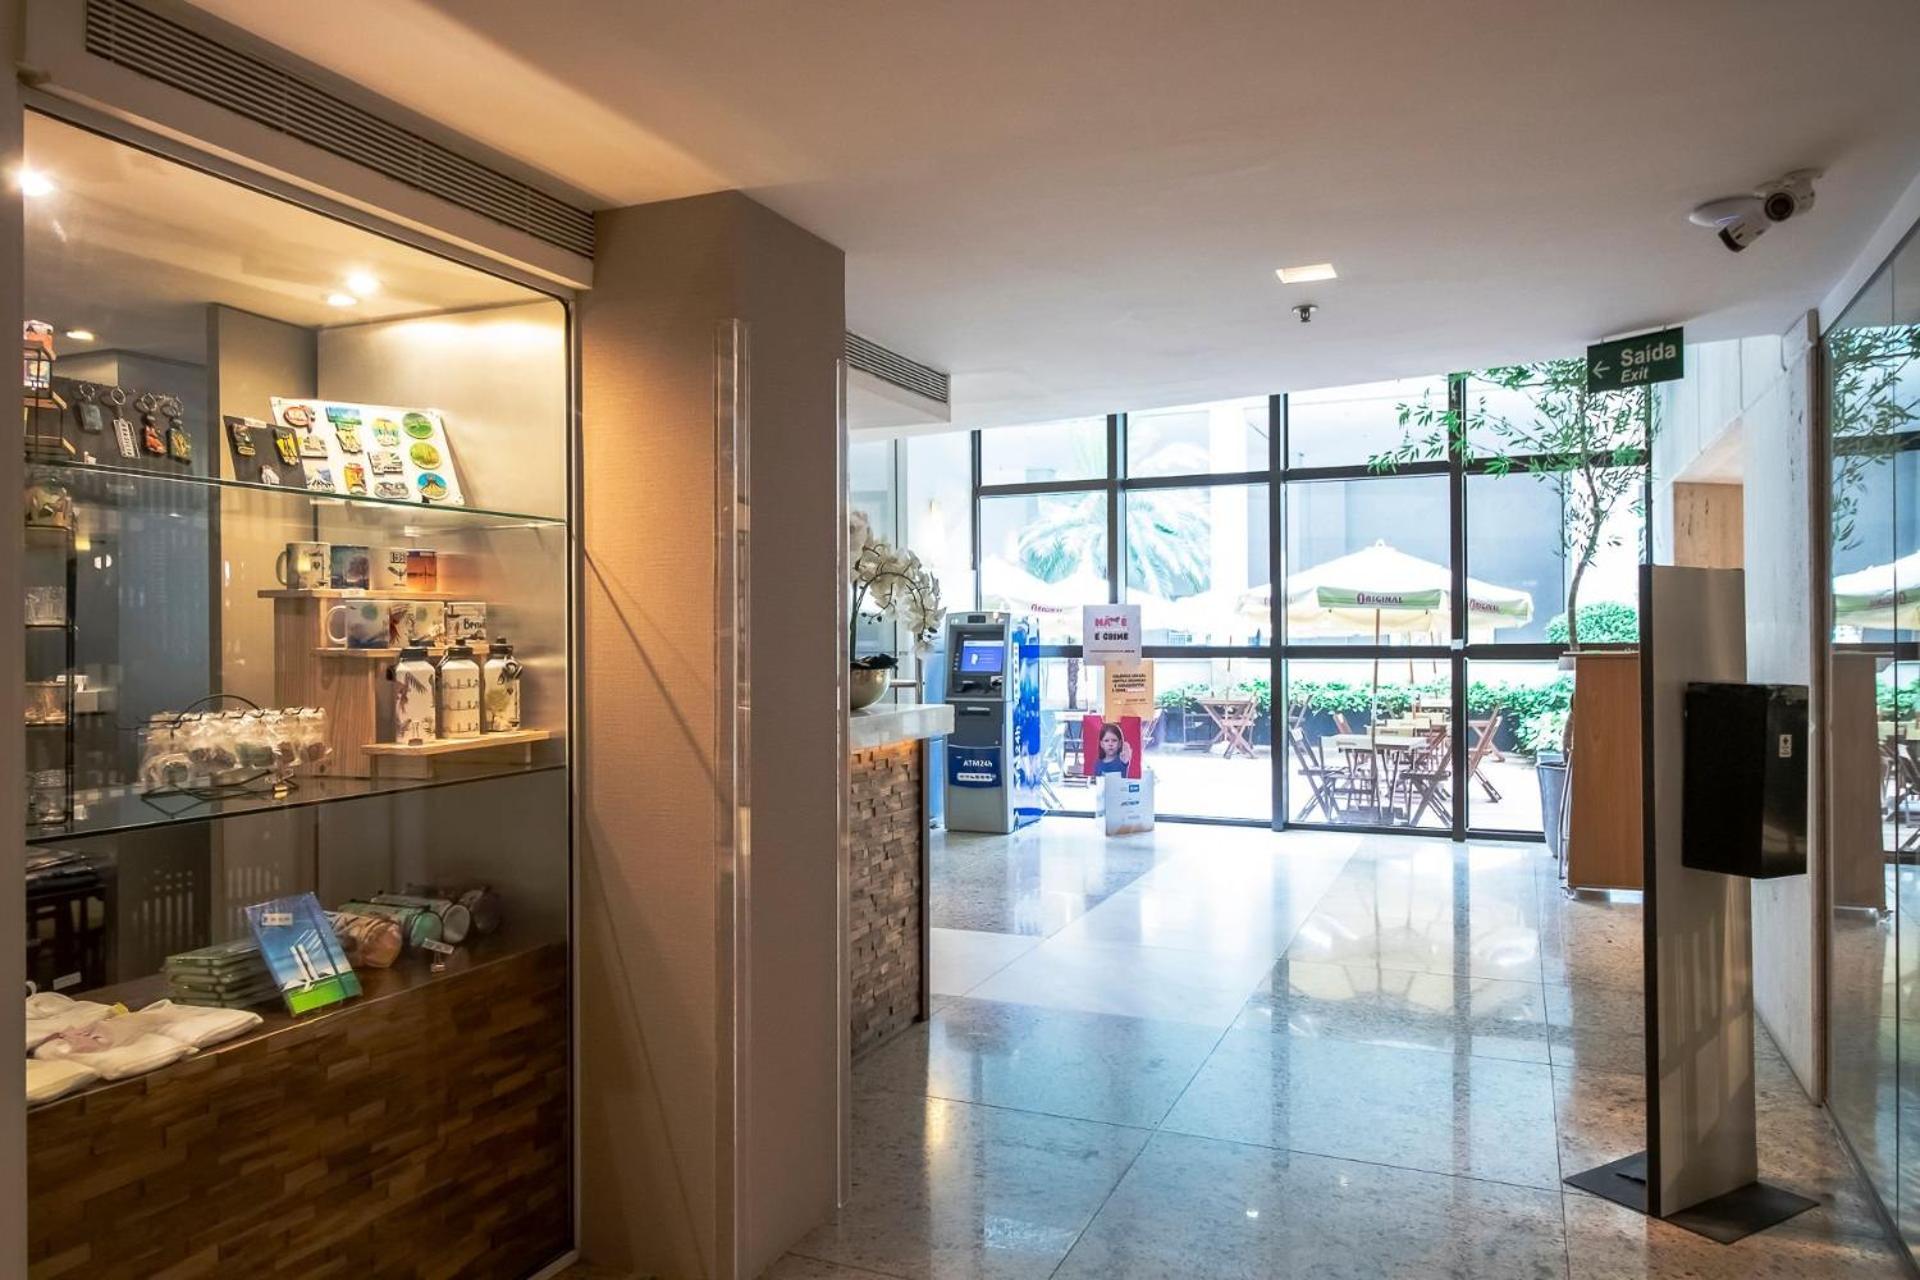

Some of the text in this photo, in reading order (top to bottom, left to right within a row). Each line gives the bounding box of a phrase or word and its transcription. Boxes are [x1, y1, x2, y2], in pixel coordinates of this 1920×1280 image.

[1620, 366, 1649, 383] Exit
[1357, 592, 1404, 604] ORIGINAL
[963, 759, 993, 768] ATM24h
